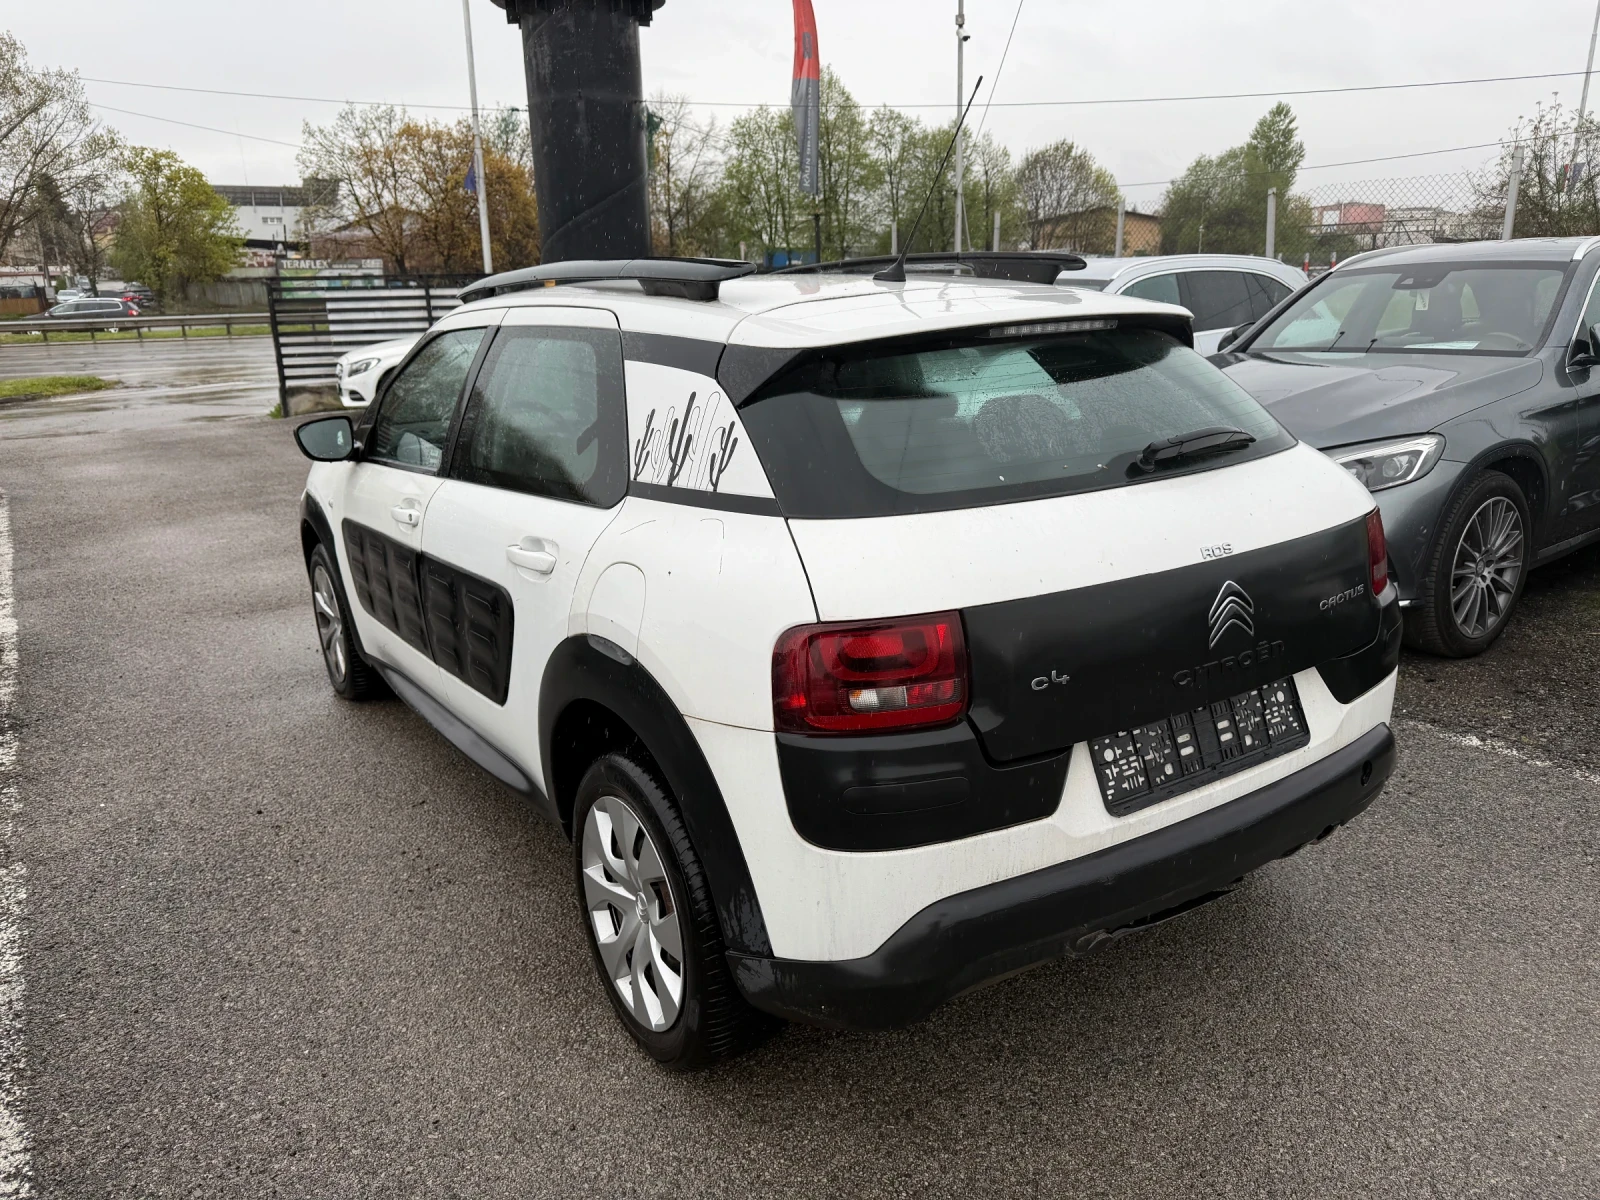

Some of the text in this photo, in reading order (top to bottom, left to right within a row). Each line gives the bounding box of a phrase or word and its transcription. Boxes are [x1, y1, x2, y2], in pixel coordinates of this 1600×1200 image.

[281, 259, 329, 269] TERAFLEX
[1319, 583, 1365, 611] CACTUS
[1031, 670, 1070, 690] C4
